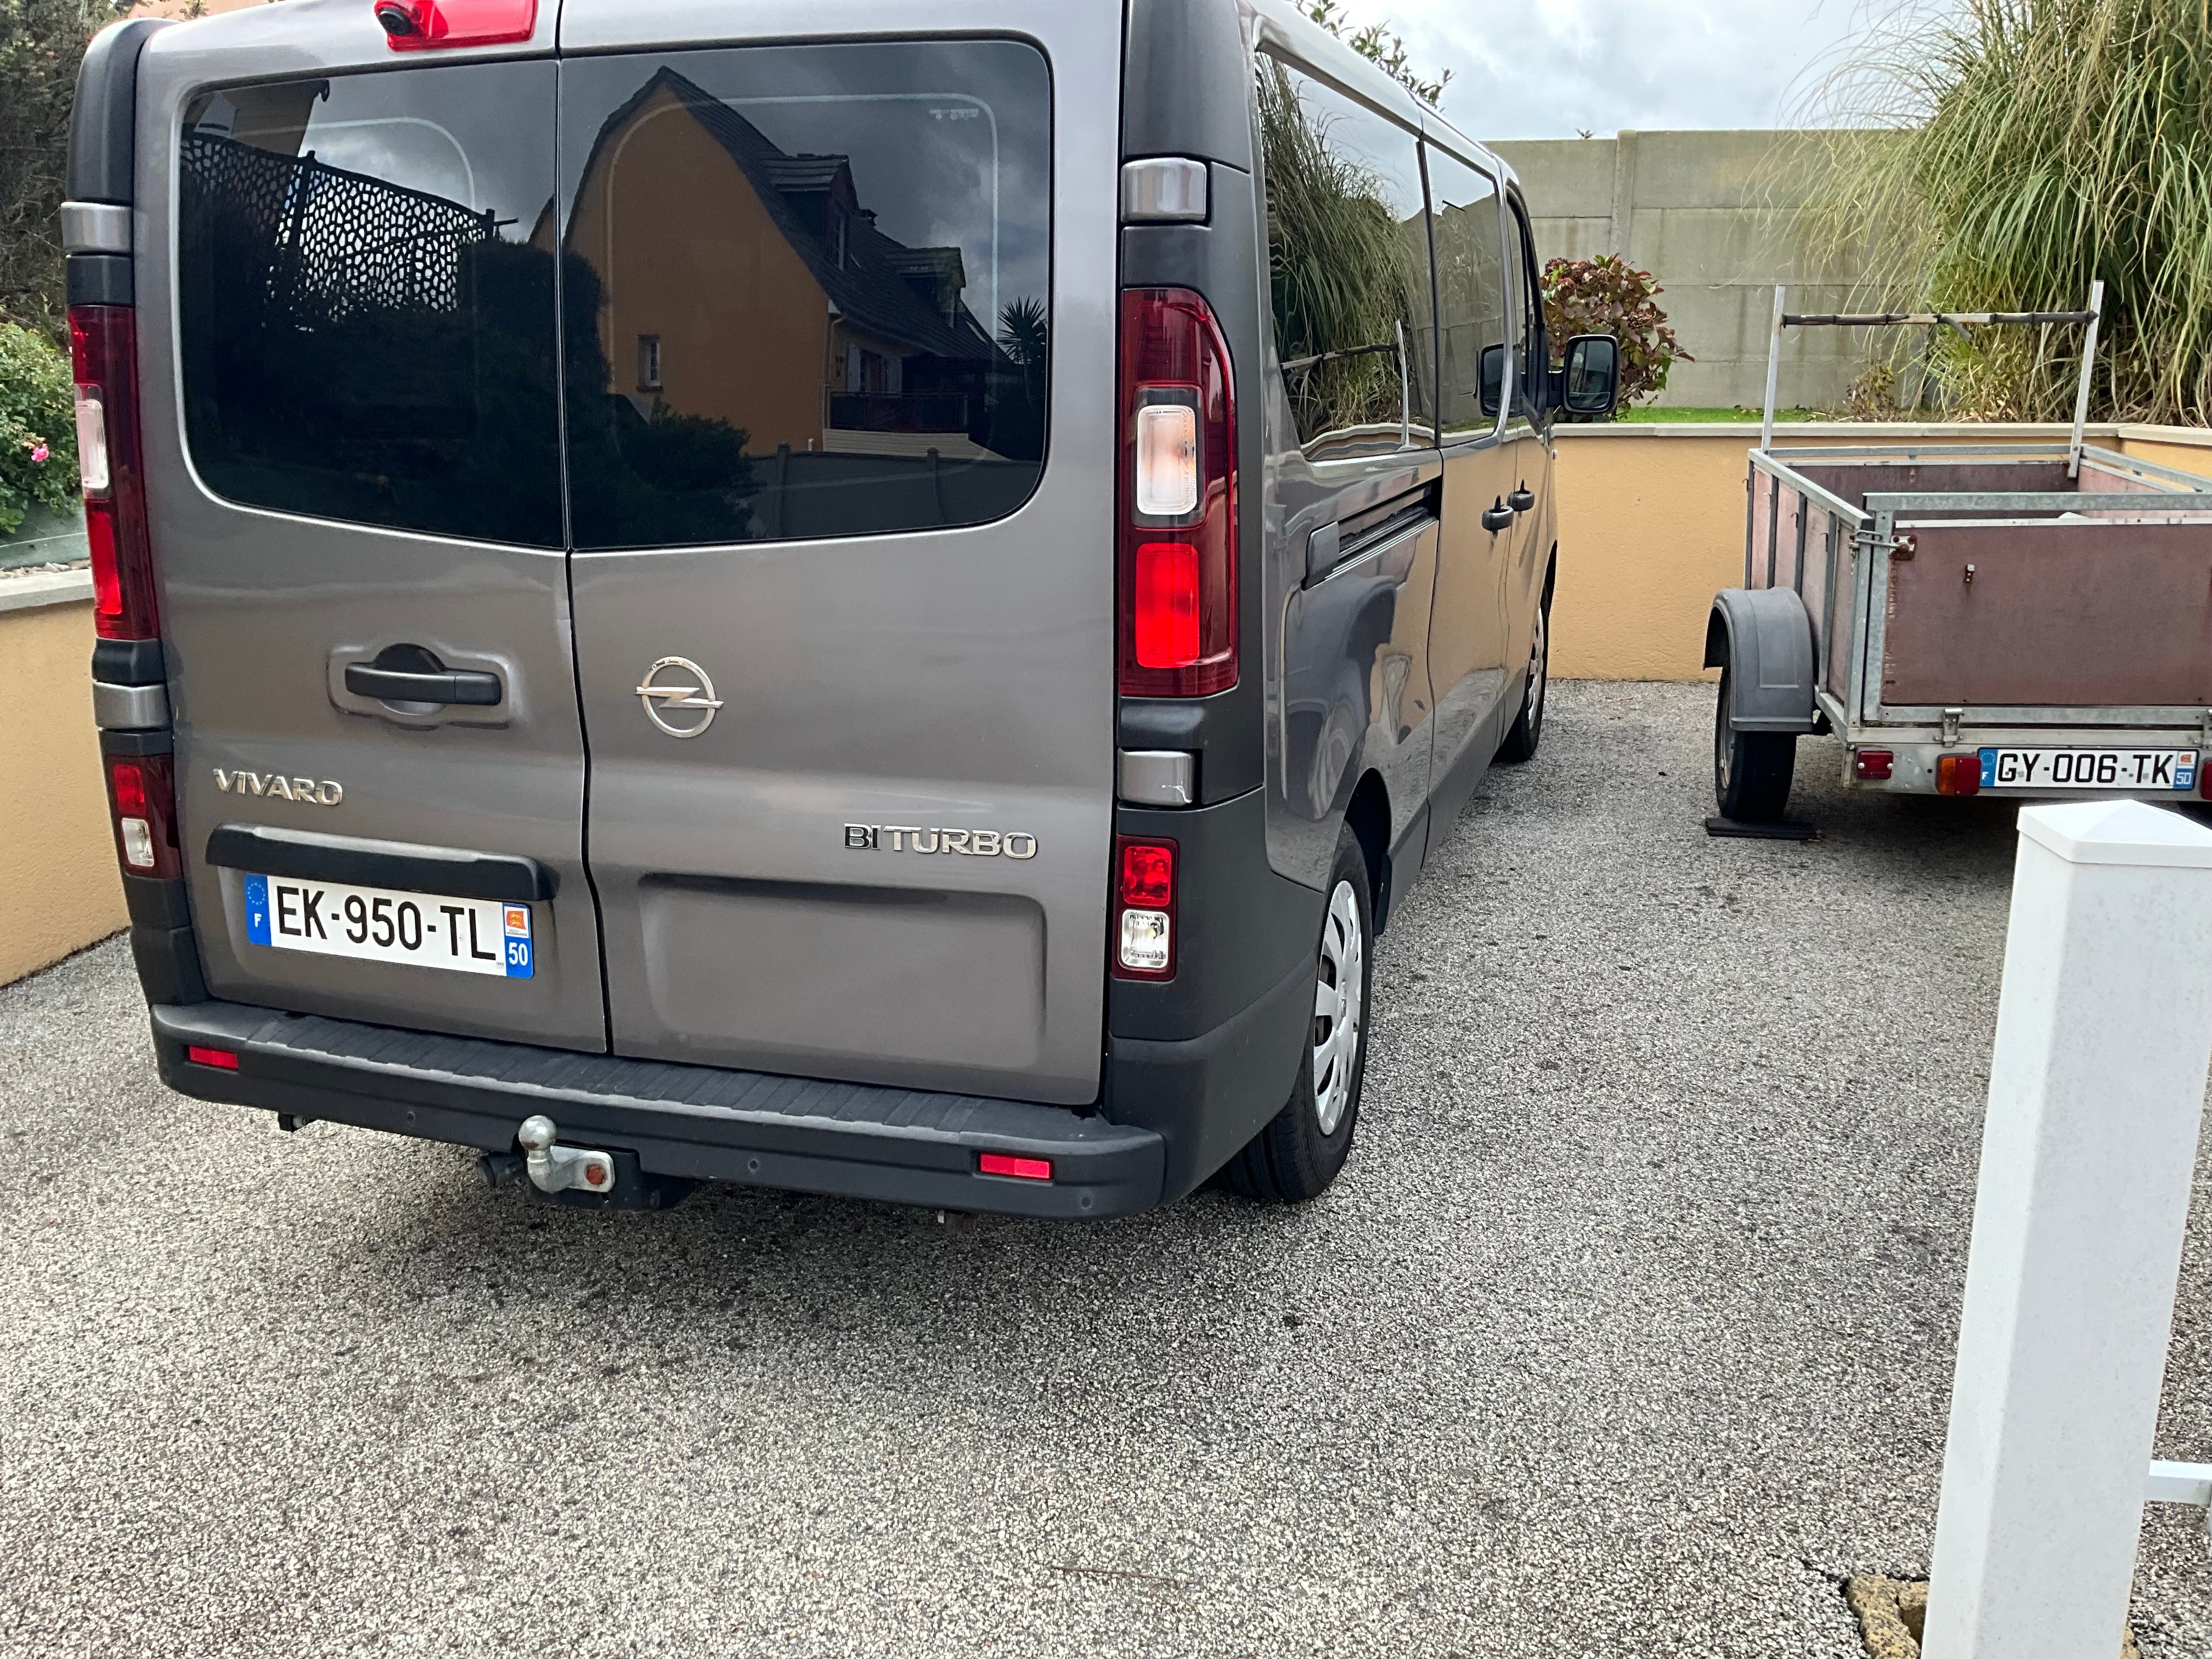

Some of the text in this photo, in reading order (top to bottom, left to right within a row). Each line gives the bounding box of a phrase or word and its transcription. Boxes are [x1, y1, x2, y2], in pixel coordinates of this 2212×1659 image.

[1982, 771, 1989, 780] F
[1997, 753, 2174, 784] GY-006-TK
[2176, 772, 2192, 785] 50
[213, 768, 343, 805] VIVARO
[254, 913, 262, 927] F
[276, 885, 496, 961] EK-950-TL
[509, 942, 528, 966] 50
